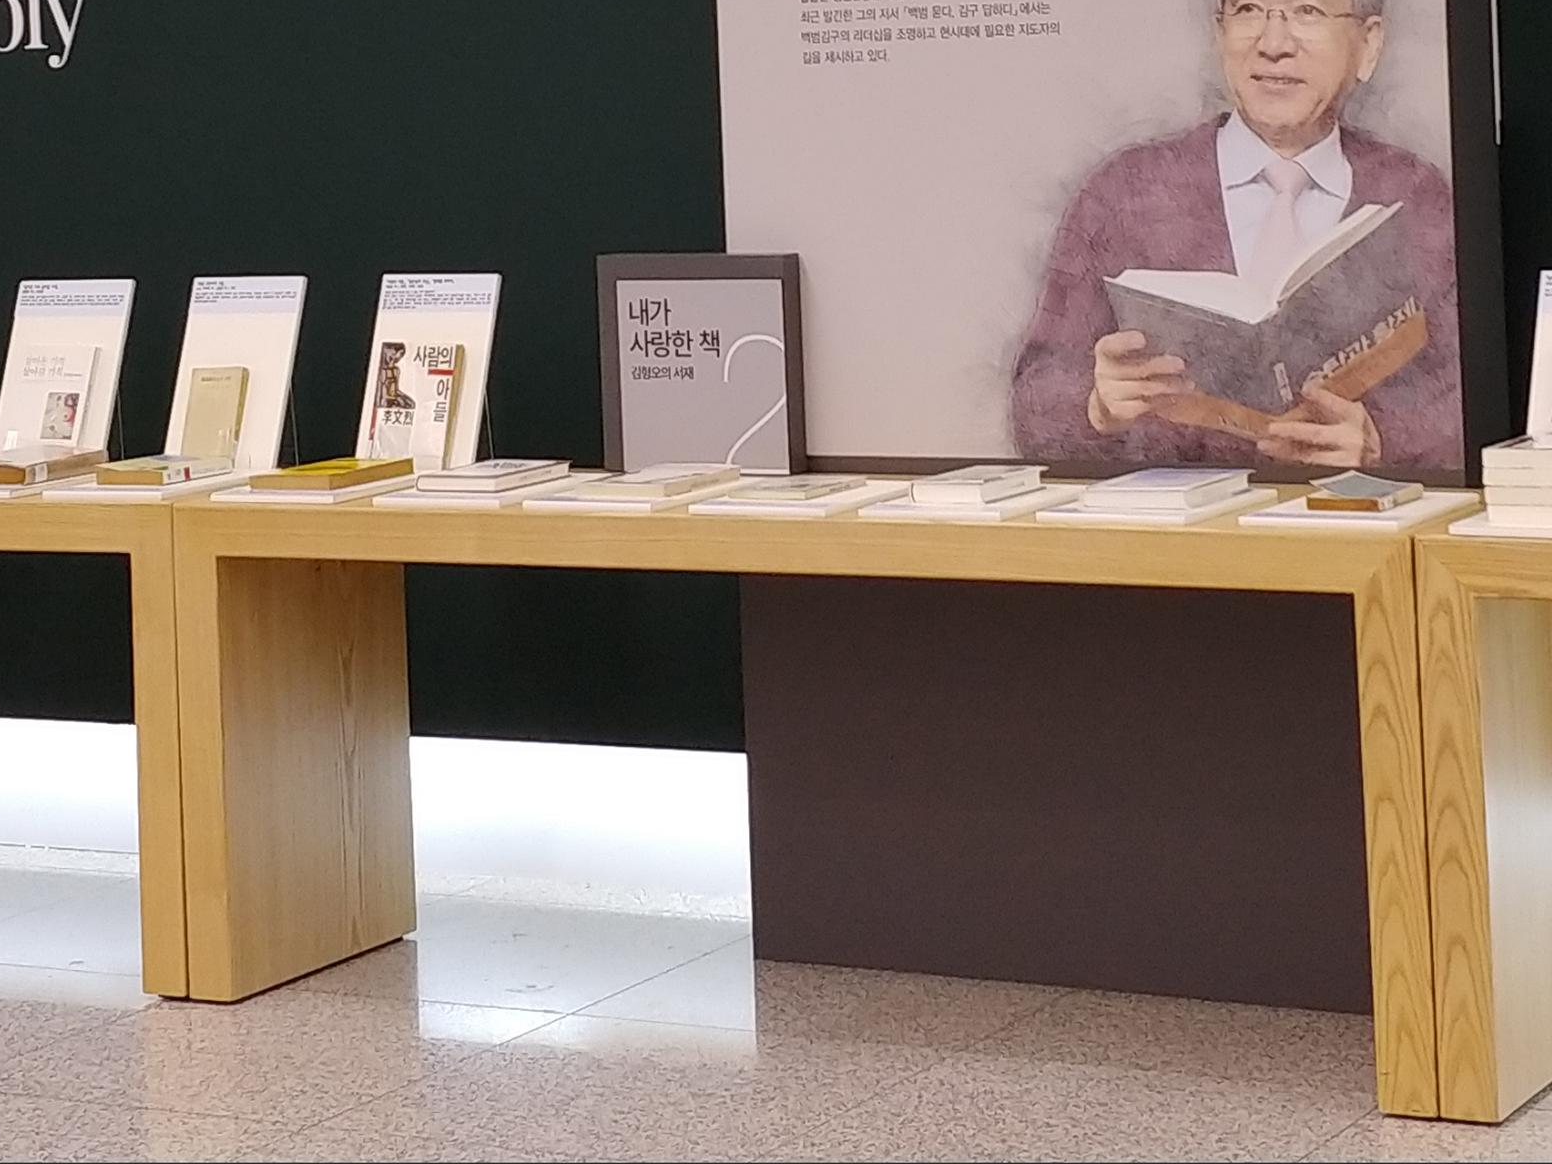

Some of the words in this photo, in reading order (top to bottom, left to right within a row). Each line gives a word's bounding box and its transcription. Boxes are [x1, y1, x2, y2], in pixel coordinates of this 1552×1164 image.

[801, 10, 819, 24] 최근
[856, 8, 876, 20] 그의
[879, 7, 900, 20] 저서
[959, 4, 978, 18] 김구
[896, 26, 936, 41] 조명하고
[984, 23, 1015, 37] 필요한
[1018, 21, 1061, 36] 지도자의
[629, 298, 672, 327] 내가
[630, 330, 694, 358] 사랑한
[699, 329, 721, 358] 책
[413, 345, 454, 368] 사람의
[631, 366, 671, 381] 김형오의
[673, 365, 695, 380] 서재
[433, 378, 450, 423] 아들
